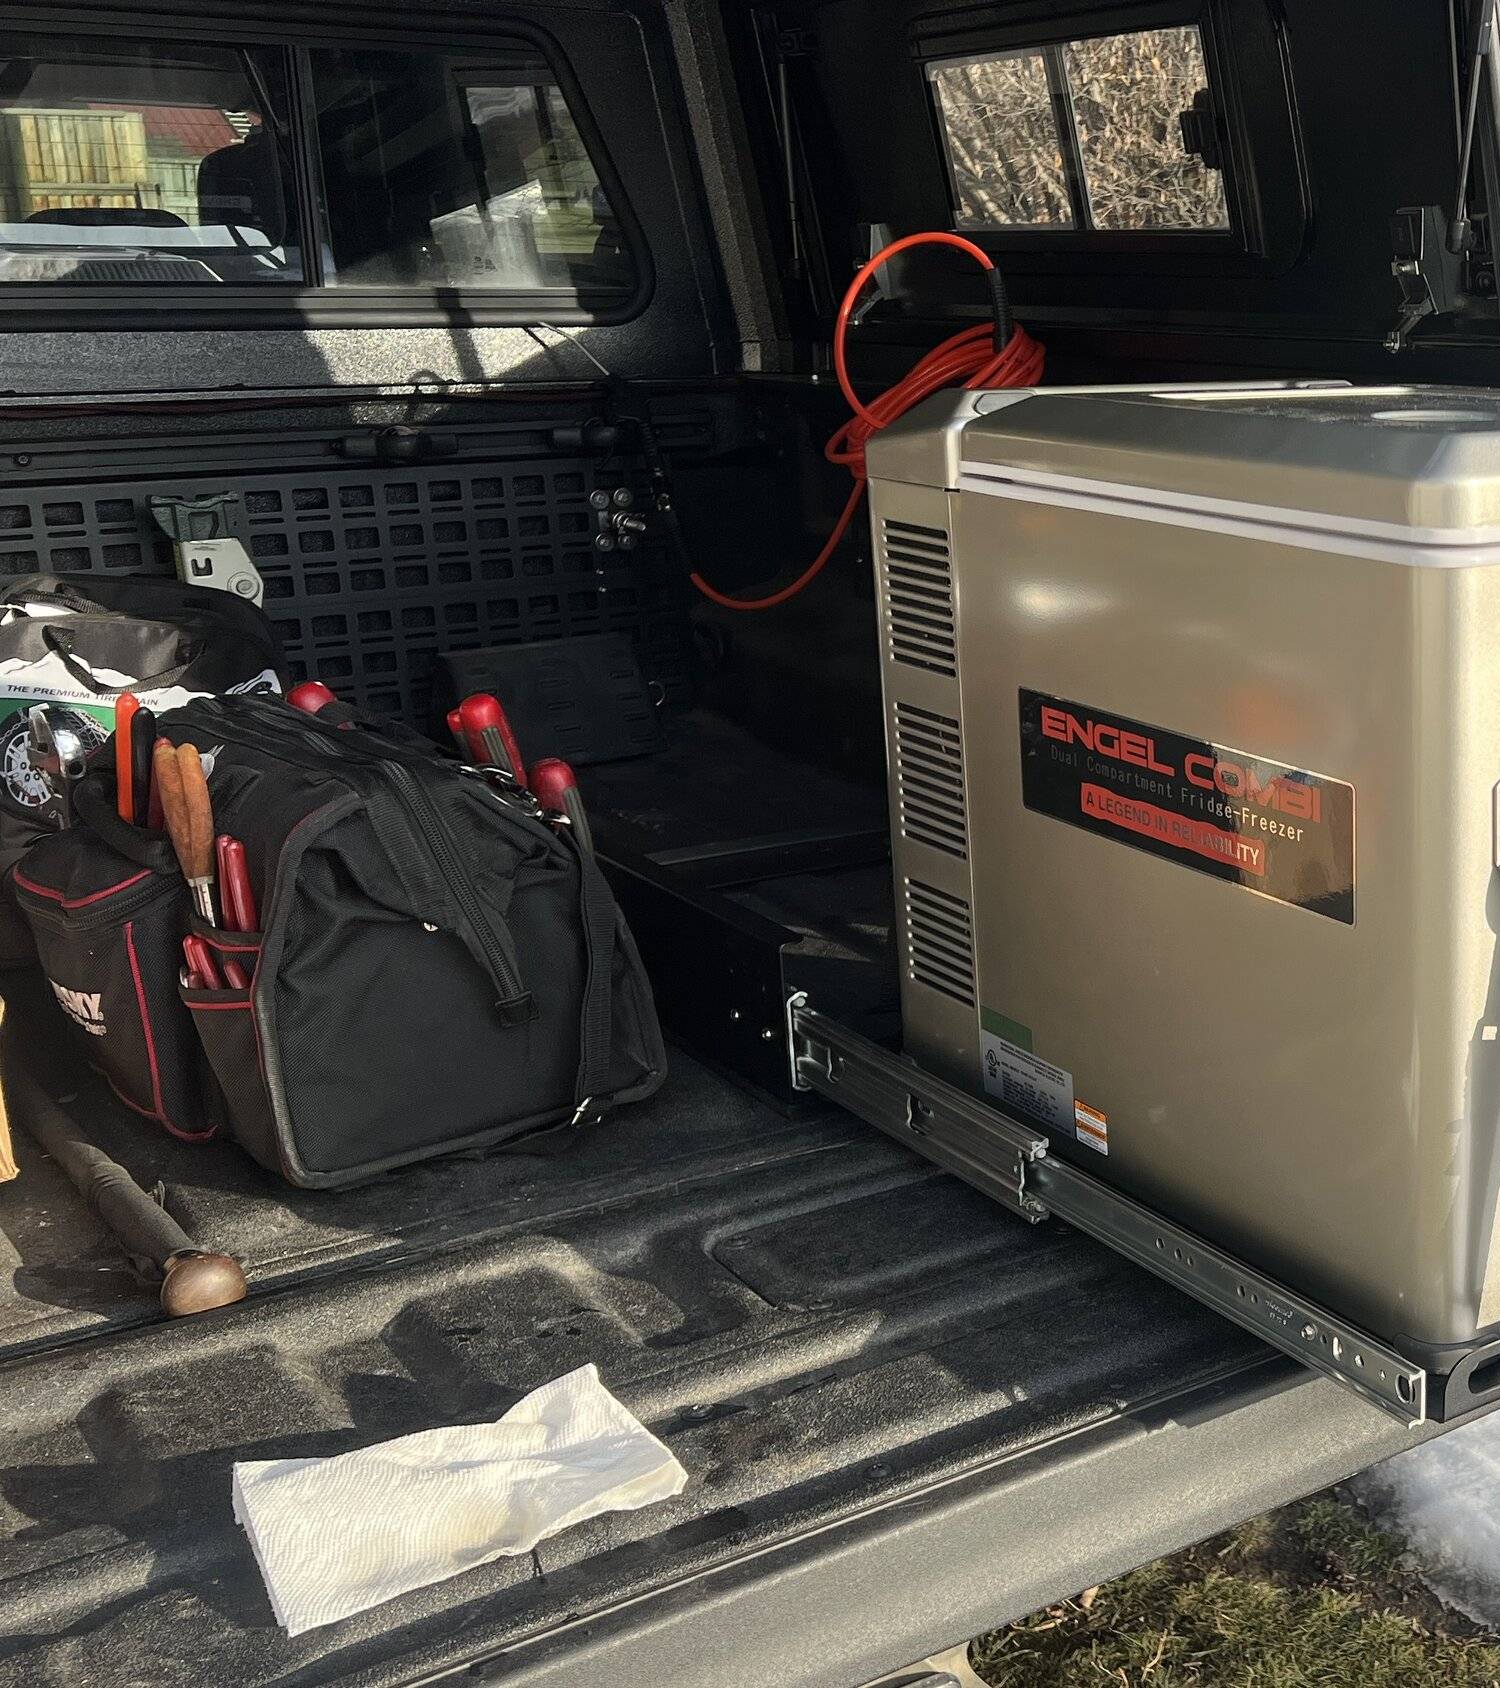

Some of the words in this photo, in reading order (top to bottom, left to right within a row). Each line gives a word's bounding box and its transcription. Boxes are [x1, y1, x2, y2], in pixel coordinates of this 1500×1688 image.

[7, 684, 30, 694] THE
[33, 687, 90, 700] PREMIUM
[1041, 705, 1175, 777] ENGEL
[1184, 752, 1322, 824] COMBI
[1050, 744, 1078, 768] Dual
[1087, 756, 1173, 799] Compartment
[1181, 788, 1304, 842] Fridge-Freezer
[1086, 791, 1095, 806] A
[1098, 795, 1151, 827] LEGEND
[1154, 814, 1169, 833] IN
[1172, 820, 1260, 866] RELIABILITY
